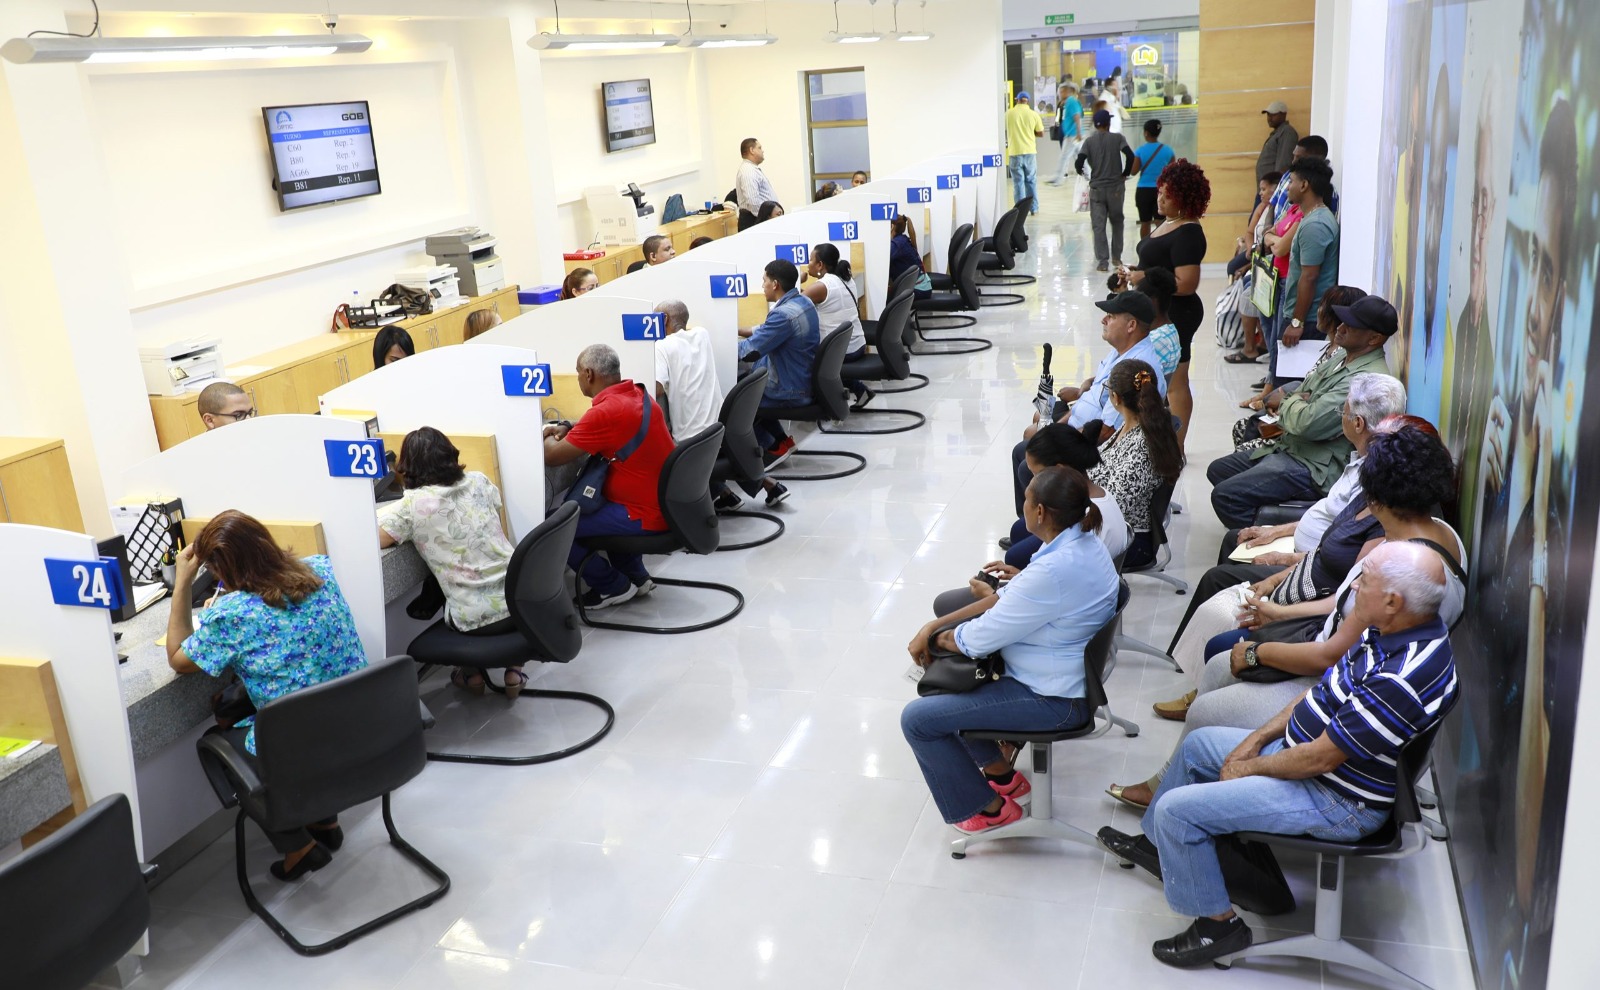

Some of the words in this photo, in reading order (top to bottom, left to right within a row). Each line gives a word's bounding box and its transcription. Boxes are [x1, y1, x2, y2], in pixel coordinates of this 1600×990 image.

[341, 113, 364, 121] GOB
[287, 144, 302, 153] C60
[334, 140, 349, 148] Rep.
[289, 156, 304, 165] B80
[336, 151, 350, 160] Rep.
[991, 155, 1002, 167] 13
[289, 168, 310, 178] AG66
[336, 164, 350, 173] Rep.
[351, 161, 360, 170] 19
[970, 164, 981, 176] 14
[294, 181, 308, 191] B81
[338, 175, 353, 185] Rep.
[947, 175, 958, 188] 15
[917, 188, 930, 202] 16
[882, 204, 895, 219] 17
[842, 222, 855, 239] 18
[791, 245, 806, 263] 19
[725, 276, 745, 297] 20
[642, 315, 661, 338] 21
[521, 367, 546, 394] 22
[347, 443, 378, 476] 23
[72, 564, 112, 607] 24
